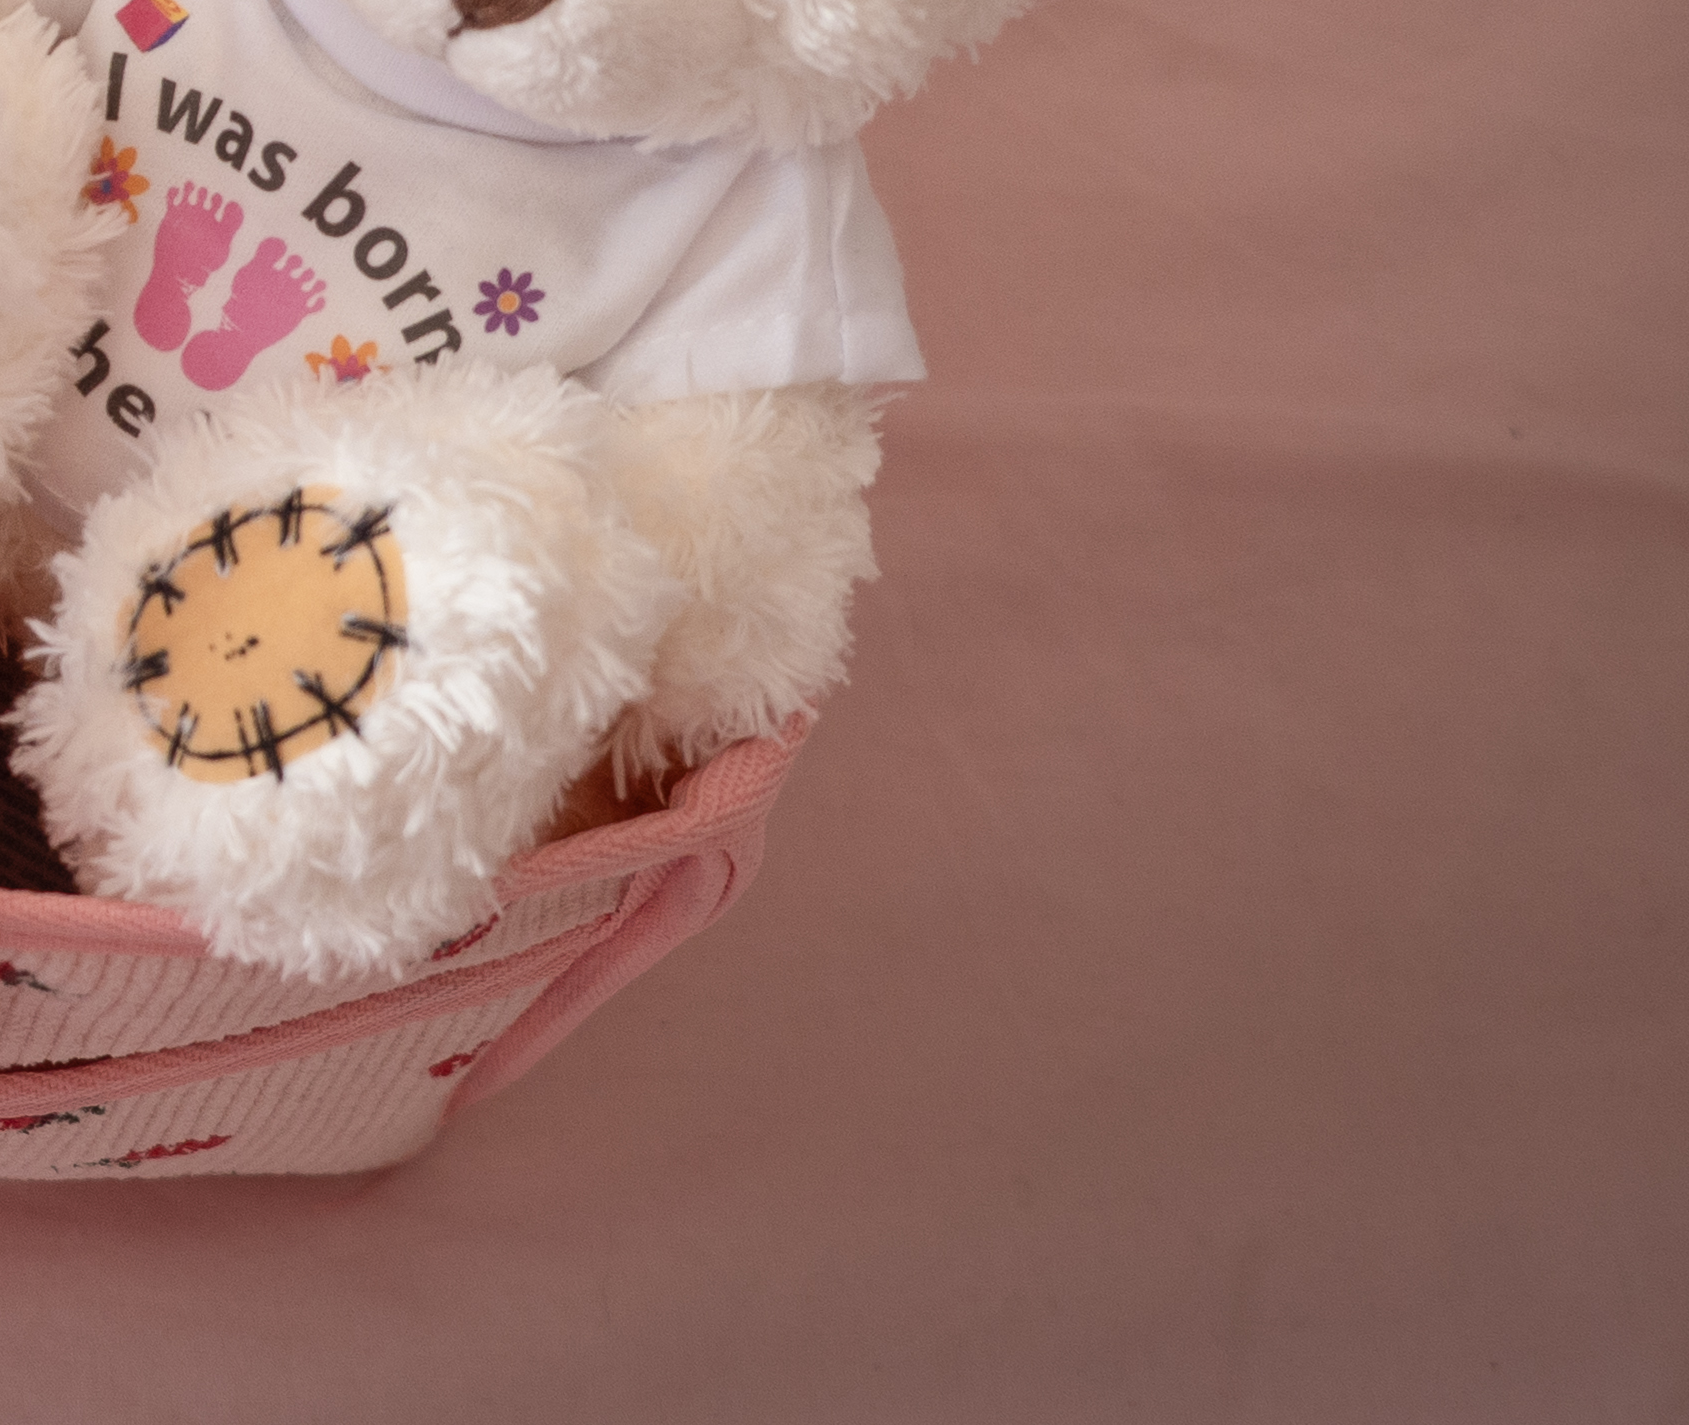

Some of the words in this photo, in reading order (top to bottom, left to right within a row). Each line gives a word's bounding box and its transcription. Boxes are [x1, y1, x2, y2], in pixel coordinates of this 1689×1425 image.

[105, 51, 128, 122] I
[156, 77, 297, 194] was
[301, 161, 464, 367] born
